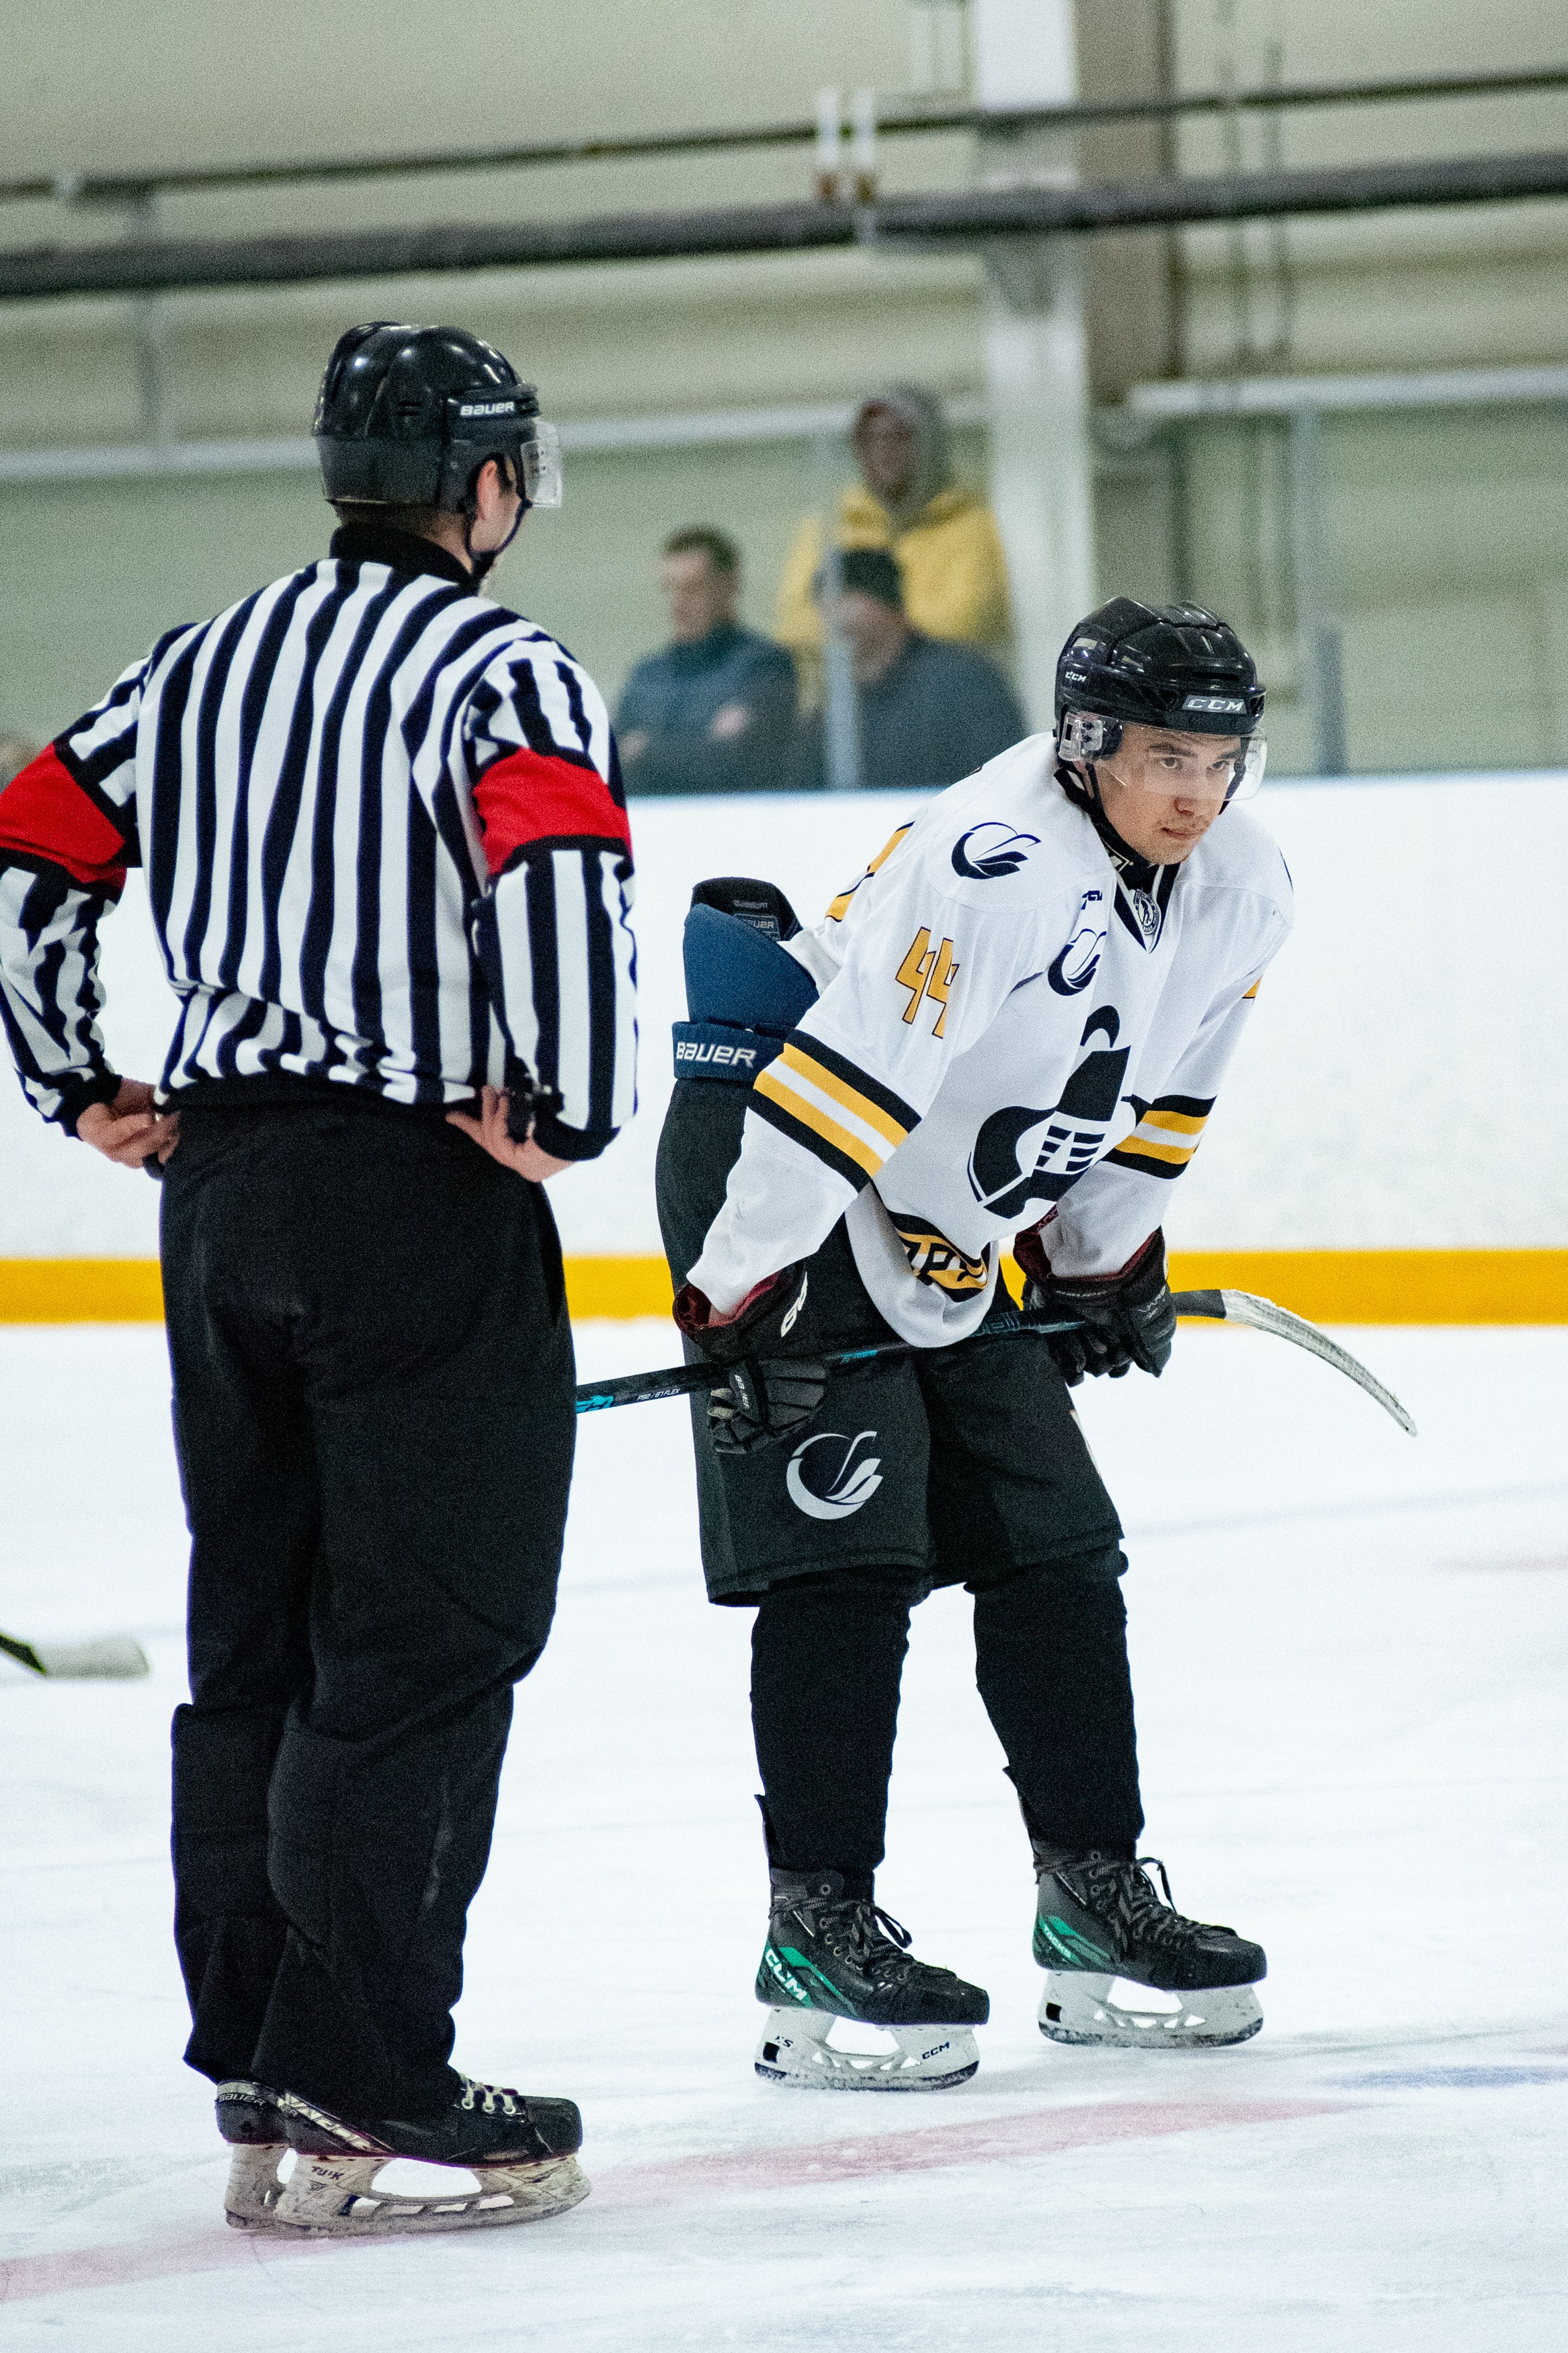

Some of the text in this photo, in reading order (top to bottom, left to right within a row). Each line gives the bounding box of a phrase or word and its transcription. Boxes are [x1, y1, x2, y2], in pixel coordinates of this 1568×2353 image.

[1065, 671, 1087, 682] CCM
[1188, 699, 1244, 711] CCM
[895, 926, 960, 1039] 44
[676, 1041, 757, 1068] BAUER
[663, 1388, 681, 1396] FLEX
[765, 1949, 807, 2000] CCM
[922, 2041, 950, 2059] CCM
